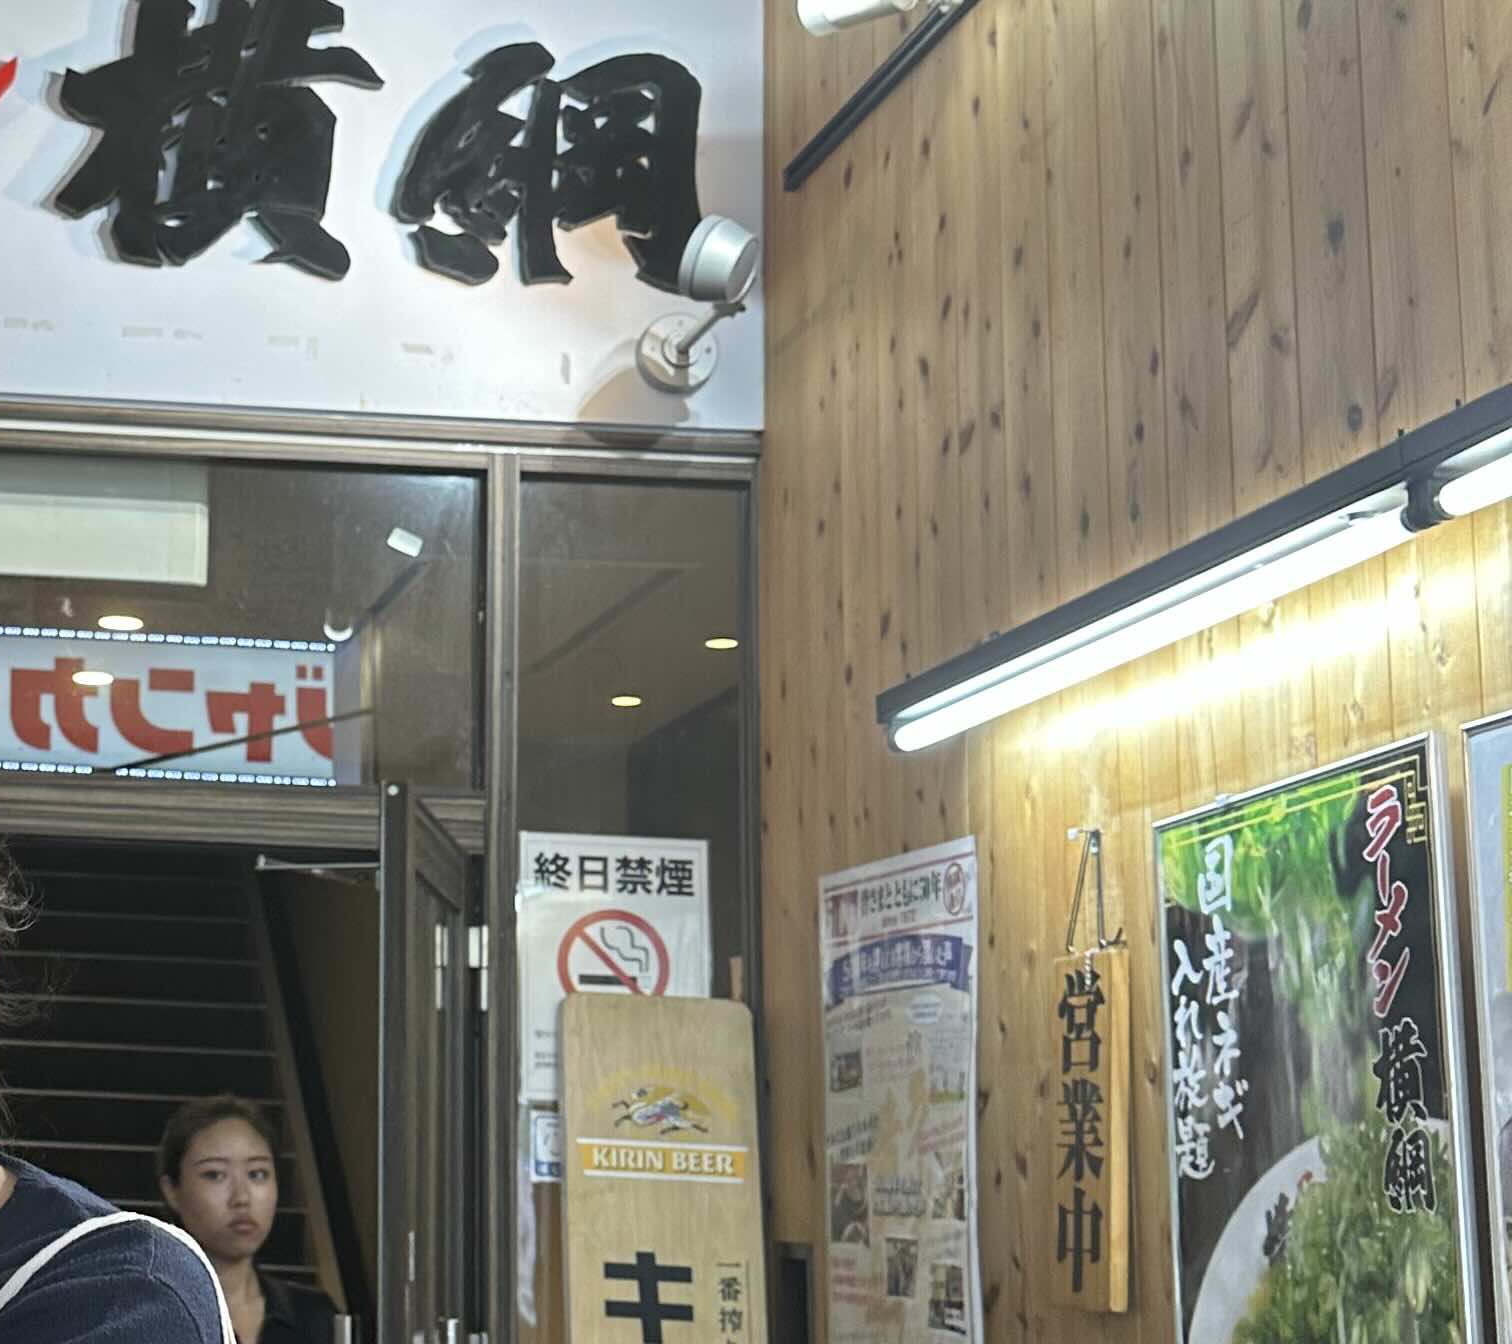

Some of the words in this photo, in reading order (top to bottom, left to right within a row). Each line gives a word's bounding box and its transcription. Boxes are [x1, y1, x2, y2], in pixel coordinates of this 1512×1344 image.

[534, 853, 696, 897] 終日禁煙
[1056, 965, 1105, 1295] 営業中
[1172, 939, 1216, 1180] 入れ放題
[592, 1146, 665, 1172] KIRIN
[671, 1149, 735, 1176] BEER
